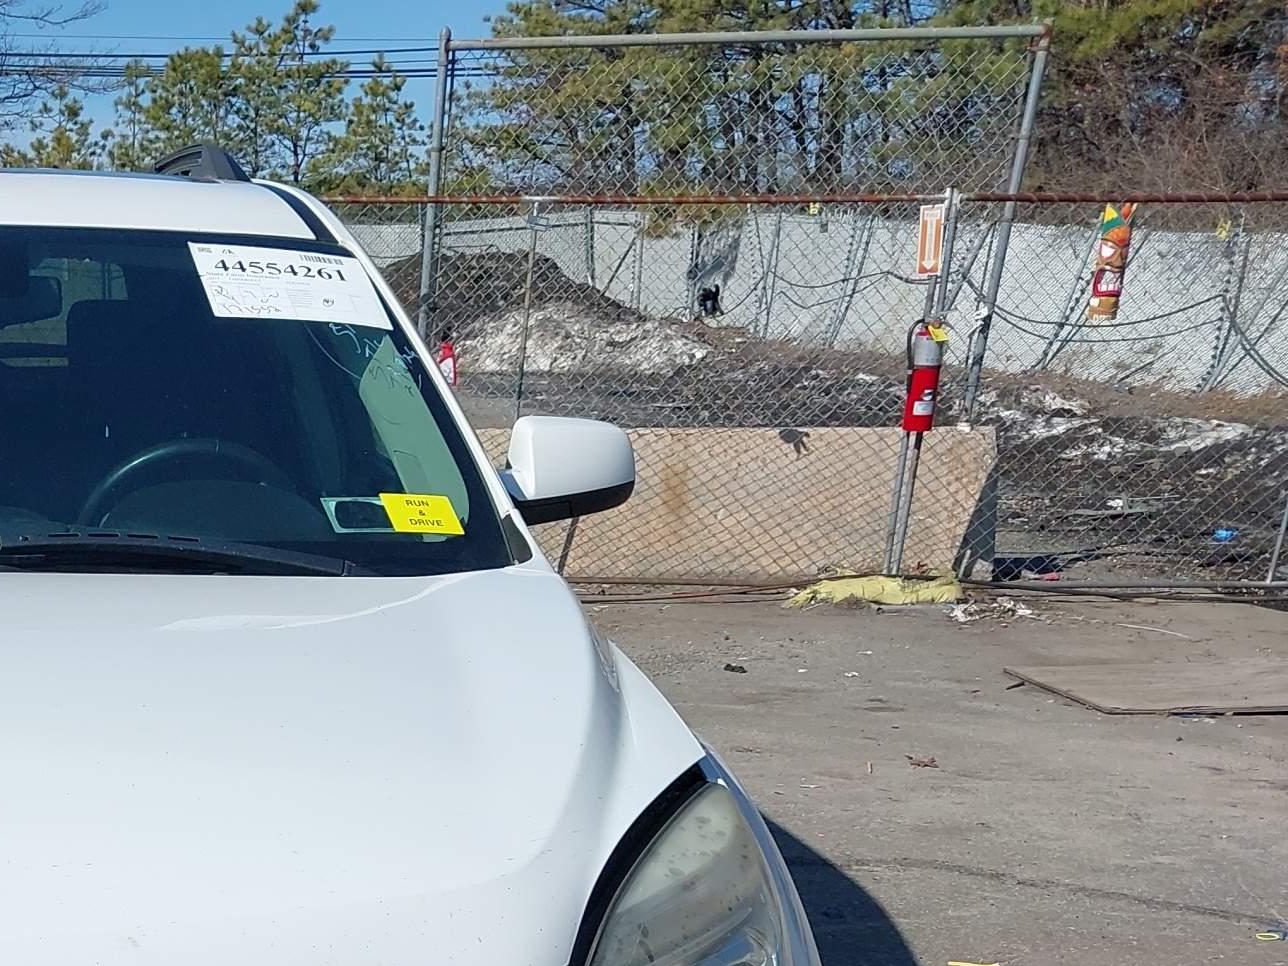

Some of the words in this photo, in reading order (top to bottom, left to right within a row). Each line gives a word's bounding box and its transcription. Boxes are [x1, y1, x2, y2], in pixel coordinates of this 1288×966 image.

[214, 259, 347, 282] 44554261
[405, 499, 429, 507] RUN
[409, 518, 444, 527] DRIVE
